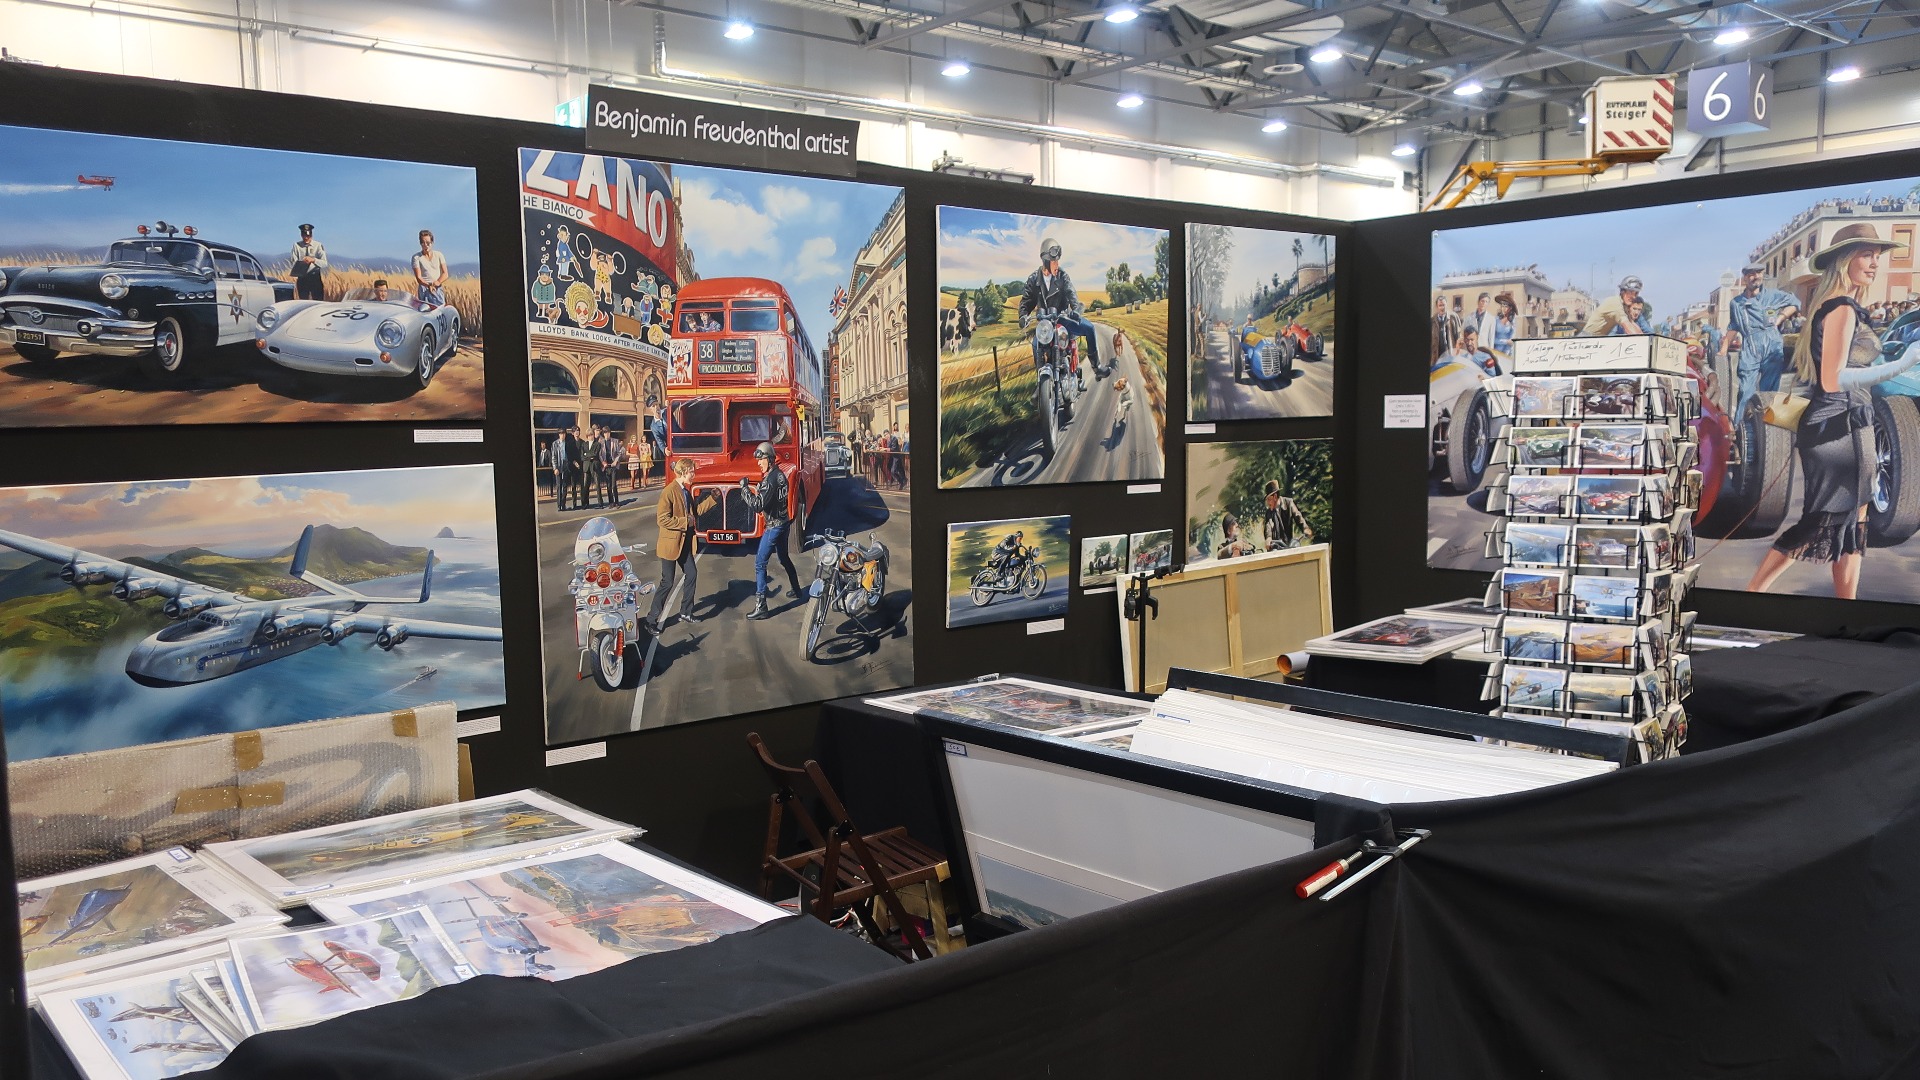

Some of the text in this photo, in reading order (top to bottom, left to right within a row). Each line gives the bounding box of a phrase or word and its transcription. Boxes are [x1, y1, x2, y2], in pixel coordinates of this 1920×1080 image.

[1703, 71, 1732, 121] 6
[1754, 73, 1766, 120] 6
[1606, 110, 1647, 120] Steiger
[595, 101, 850, 156] Benjamin Freudenthal artist
[526, 149, 668, 248] ZANO
[543, 198, 584, 220] BIANCO
[538, 325, 566, 335] LLOYDS
[570, 329, 589, 339] BANK
[592, 333, 611, 343] LOOKS
[613, 338, 631, 347] AFTER
[632, 342, 650, 353] PEOPLE
[700, 343, 714, 359] 38
[702, 363, 752, 373] PICCADILLY CIRCUS
[713, 533, 734, 541] SLT 56
